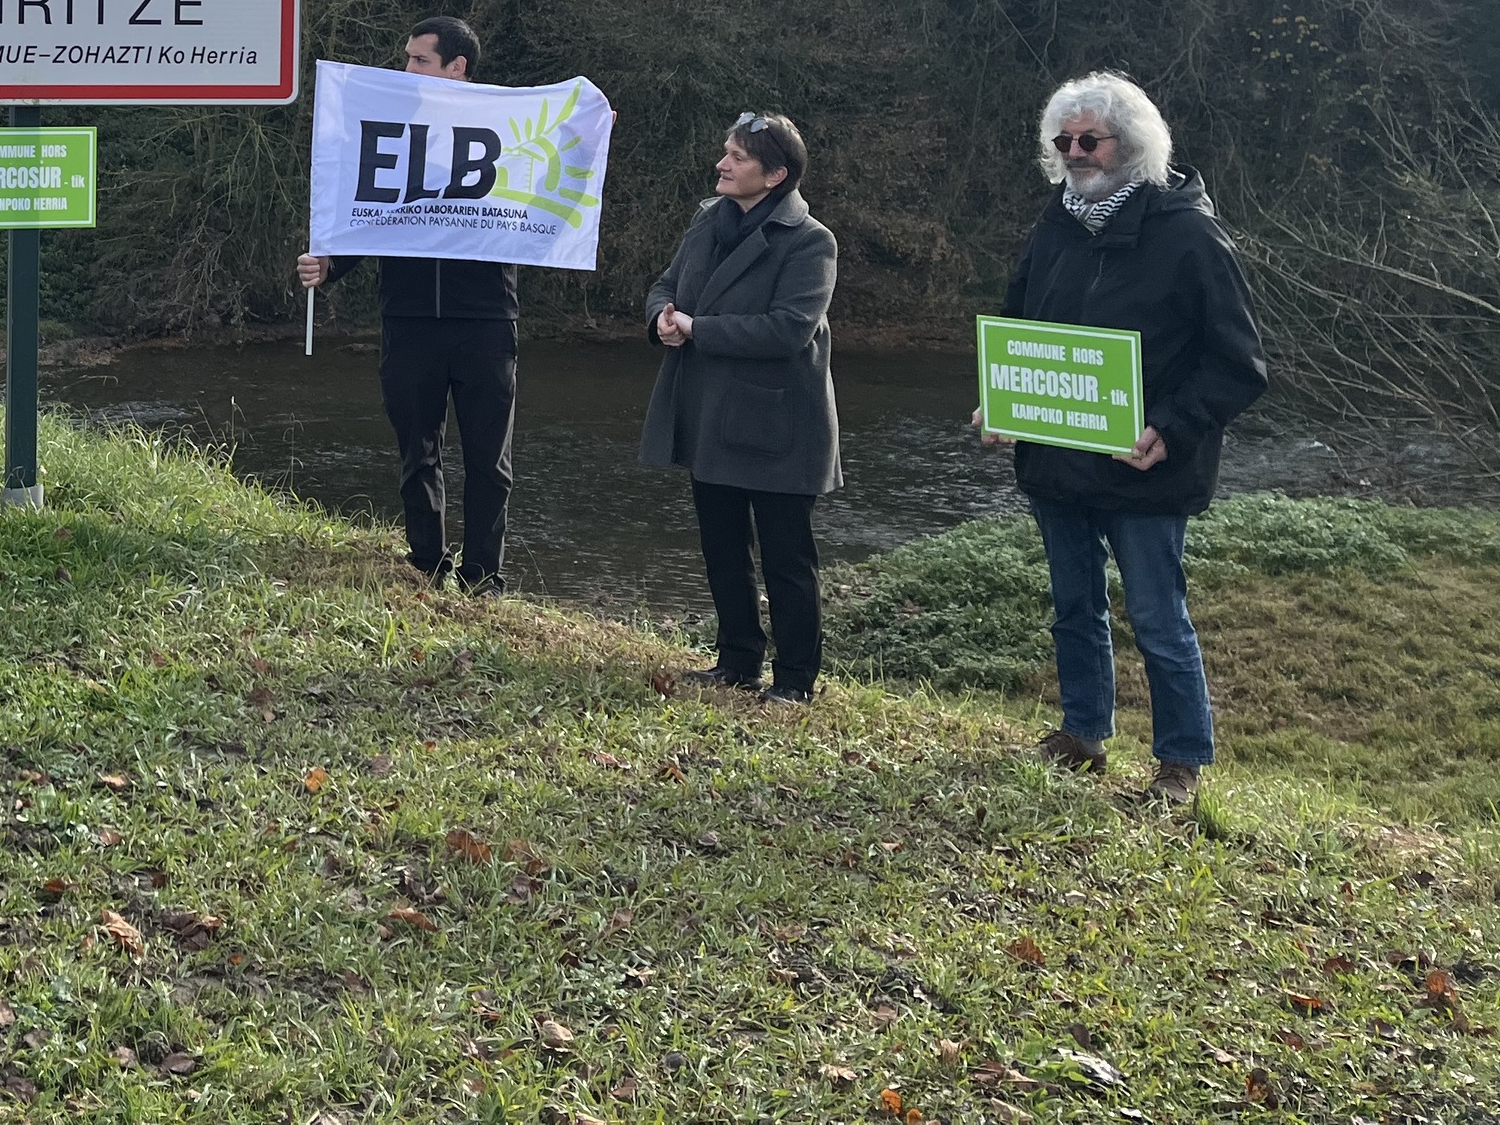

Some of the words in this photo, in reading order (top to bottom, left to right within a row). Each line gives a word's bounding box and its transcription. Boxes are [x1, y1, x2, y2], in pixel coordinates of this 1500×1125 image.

[157, 45, 185, 64] Ko
[190, 45, 258, 64] Herria
[41, 144, 68, 158] HORS
[353, 119, 502, 204] ELB
[71, 174, 86, 188] tik
[33, 197, 68, 211] HERRIA
[424, 205, 479, 216] LABORARIEN
[482, 207, 528, 220] BATASUNA
[428, 216, 478, 229] PAYSANNE
[480, 218, 494, 230] DU
[496, 219, 518, 232] PAYS
[519, 222, 557, 236] BASQUE
[1007, 339, 1066, 362] COMMUNE
[1072, 347, 1104, 366] HORS
[990, 363, 1099, 403] MERCOSUR
[1110, 388, 1129, 407] tik
[1011, 402, 1064, 425] KANPOKO
[1066, 410, 1109, 432] HERRIA
